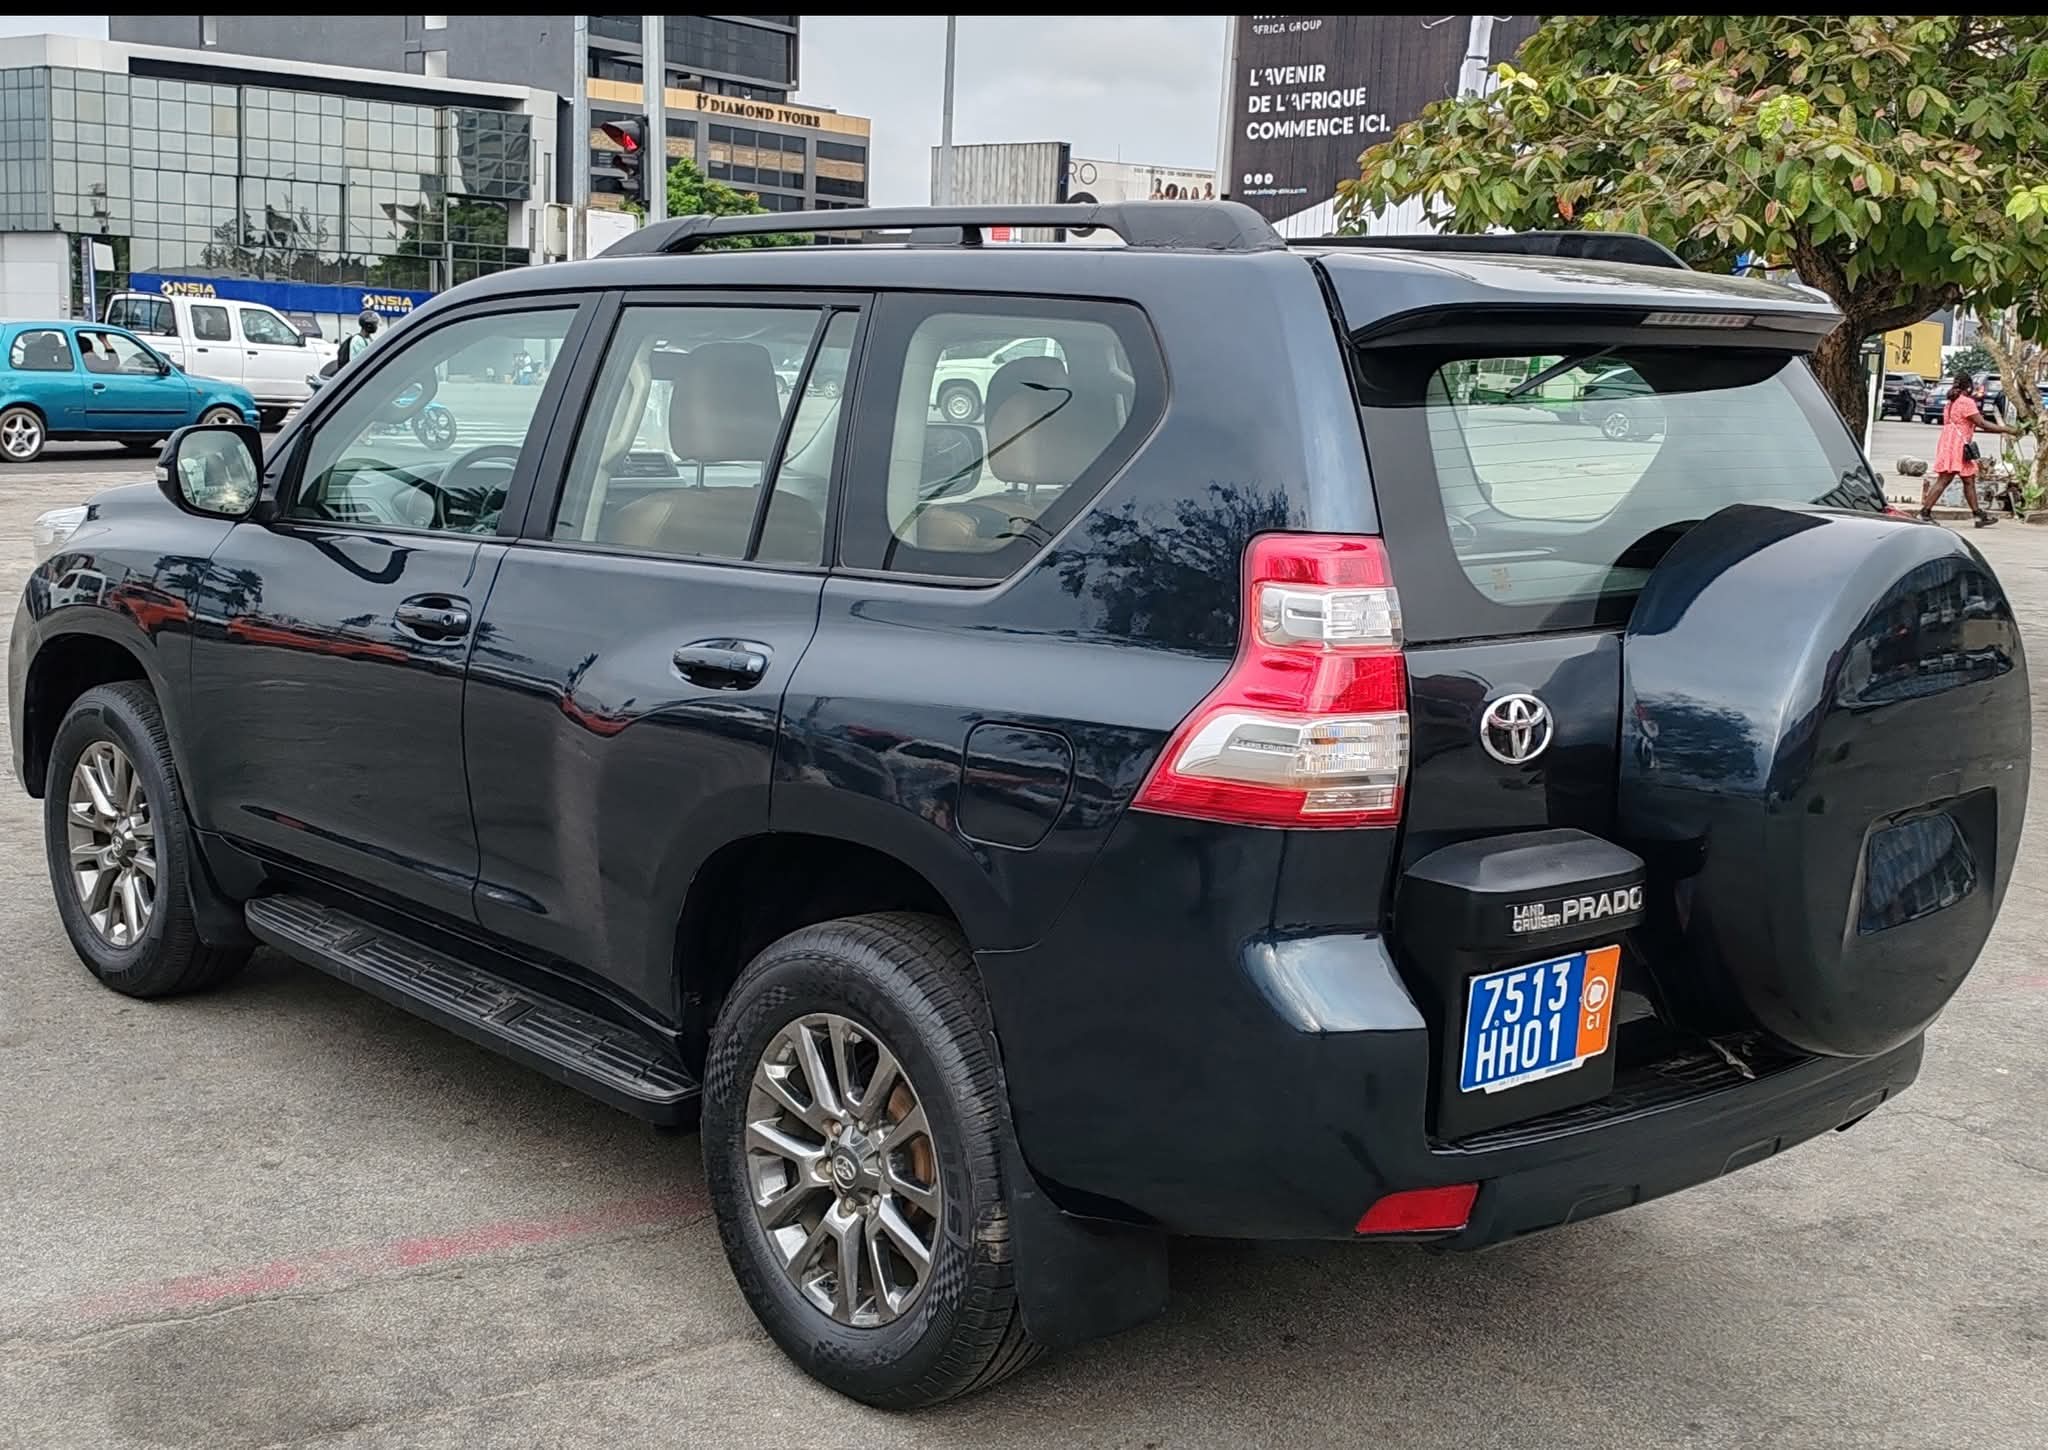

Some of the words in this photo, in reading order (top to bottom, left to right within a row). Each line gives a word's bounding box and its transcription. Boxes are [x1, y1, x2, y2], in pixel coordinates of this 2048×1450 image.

[1253, 23, 1286, 35] AFRICA
[1288, 20, 1322, 32] GROUP
[1248, 95, 1271, 113] DE
[710, 99, 774, 120] DIAMOND
[778, 109, 820, 128] IVOIRE
[1246, 116, 1354, 140] COMMENCE
[1359, 114, 1391, 133] ICI.
[174, 282, 216, 294] NSIA
[374, 295, 413, 307] NSIA
[1513, 903, 1545, 919] LAND
[1562, 886, 1643, 924] PRADO
[1512, 914, 1561, 932] CRUISER
[1481, 962, 1571, 1030] 7513
[1475, 1013, 1561, 1082] HH01
